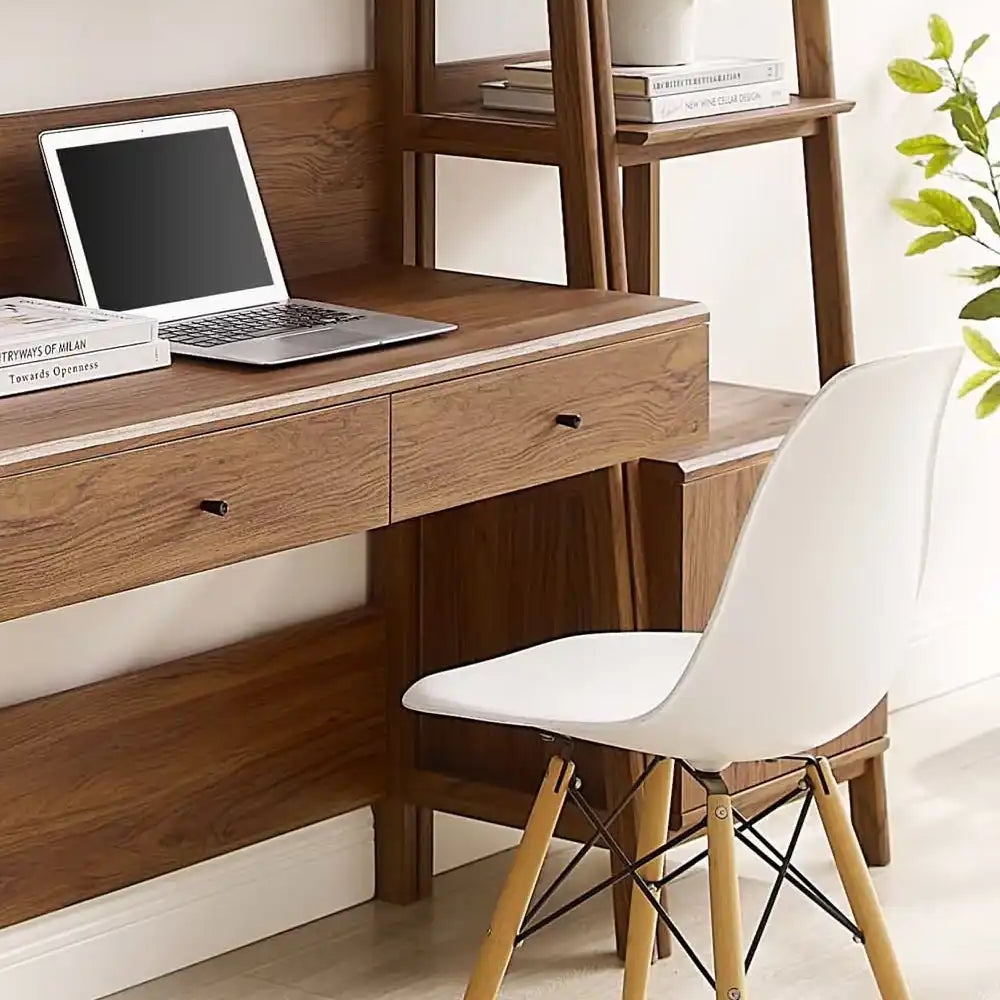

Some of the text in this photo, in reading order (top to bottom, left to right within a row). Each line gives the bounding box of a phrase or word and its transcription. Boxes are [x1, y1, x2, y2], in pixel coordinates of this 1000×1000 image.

[717, 94, 738, 106] CELLAR
[45, 343, 57, 355] OF
[58, 338, 87, 353] MILAN
[9, 360, 99, 385] Towards Openness
